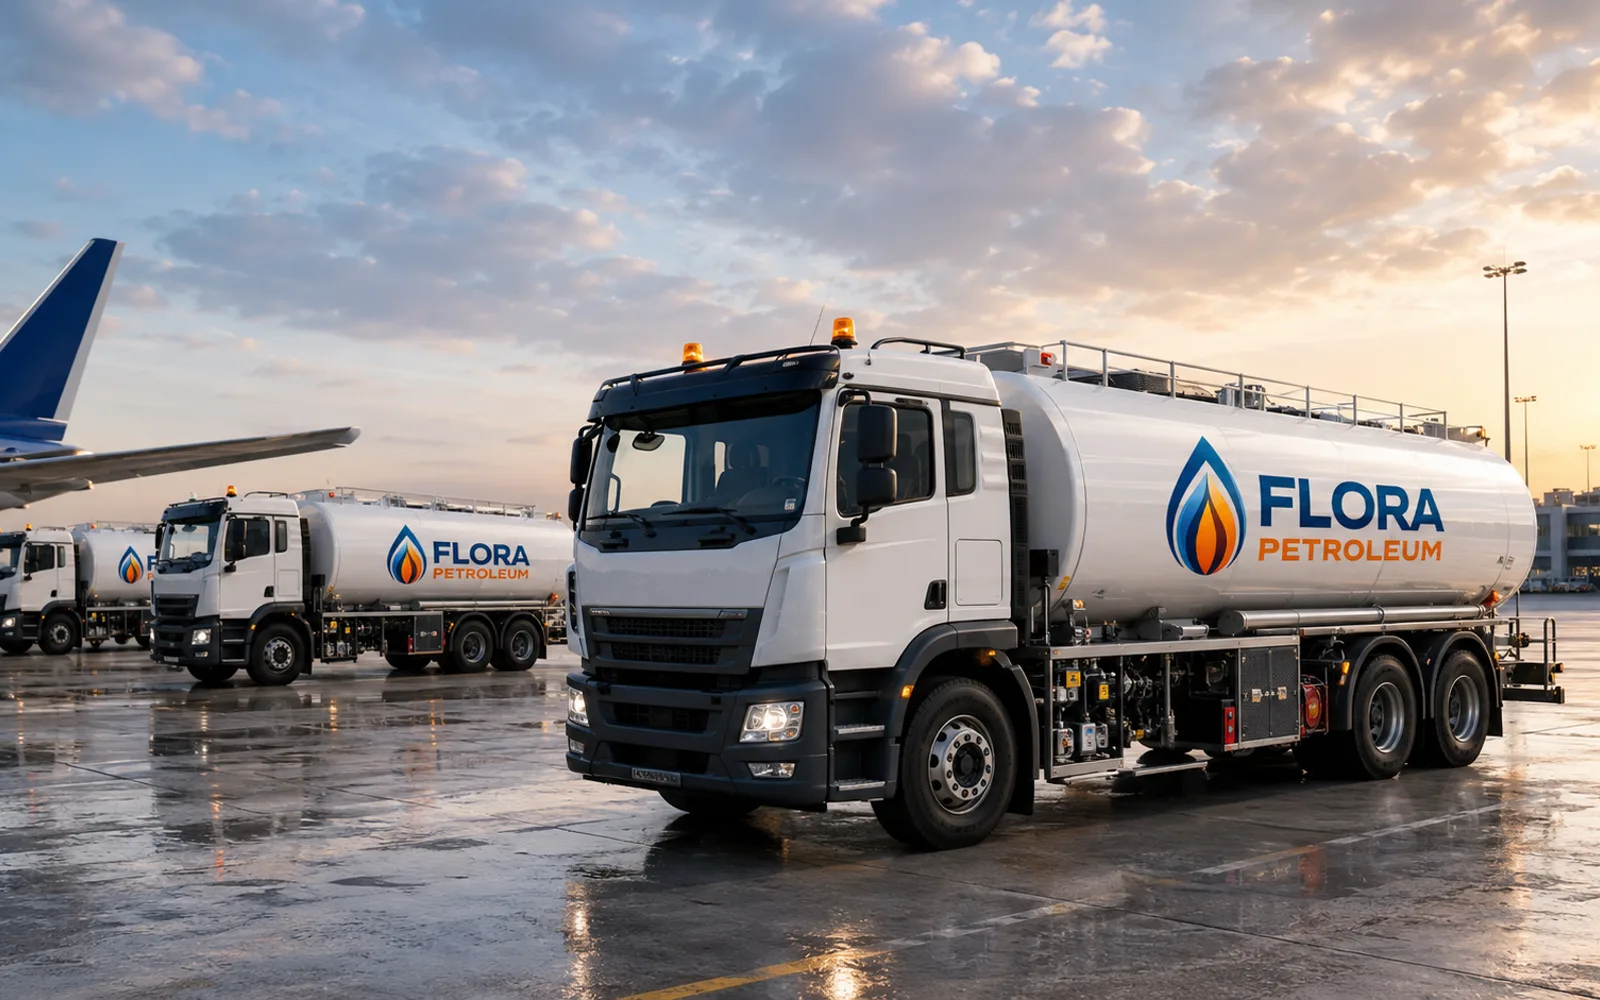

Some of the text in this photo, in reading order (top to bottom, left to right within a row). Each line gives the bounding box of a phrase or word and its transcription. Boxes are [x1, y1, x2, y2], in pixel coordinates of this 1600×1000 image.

[1258, 474, 1445, 532] FLORA
[433, 541, 530, 566] FLORA
[1258, 538, 1442, 561] PETROLEUM
[433, 568, 529, 579] PETROLEUM
